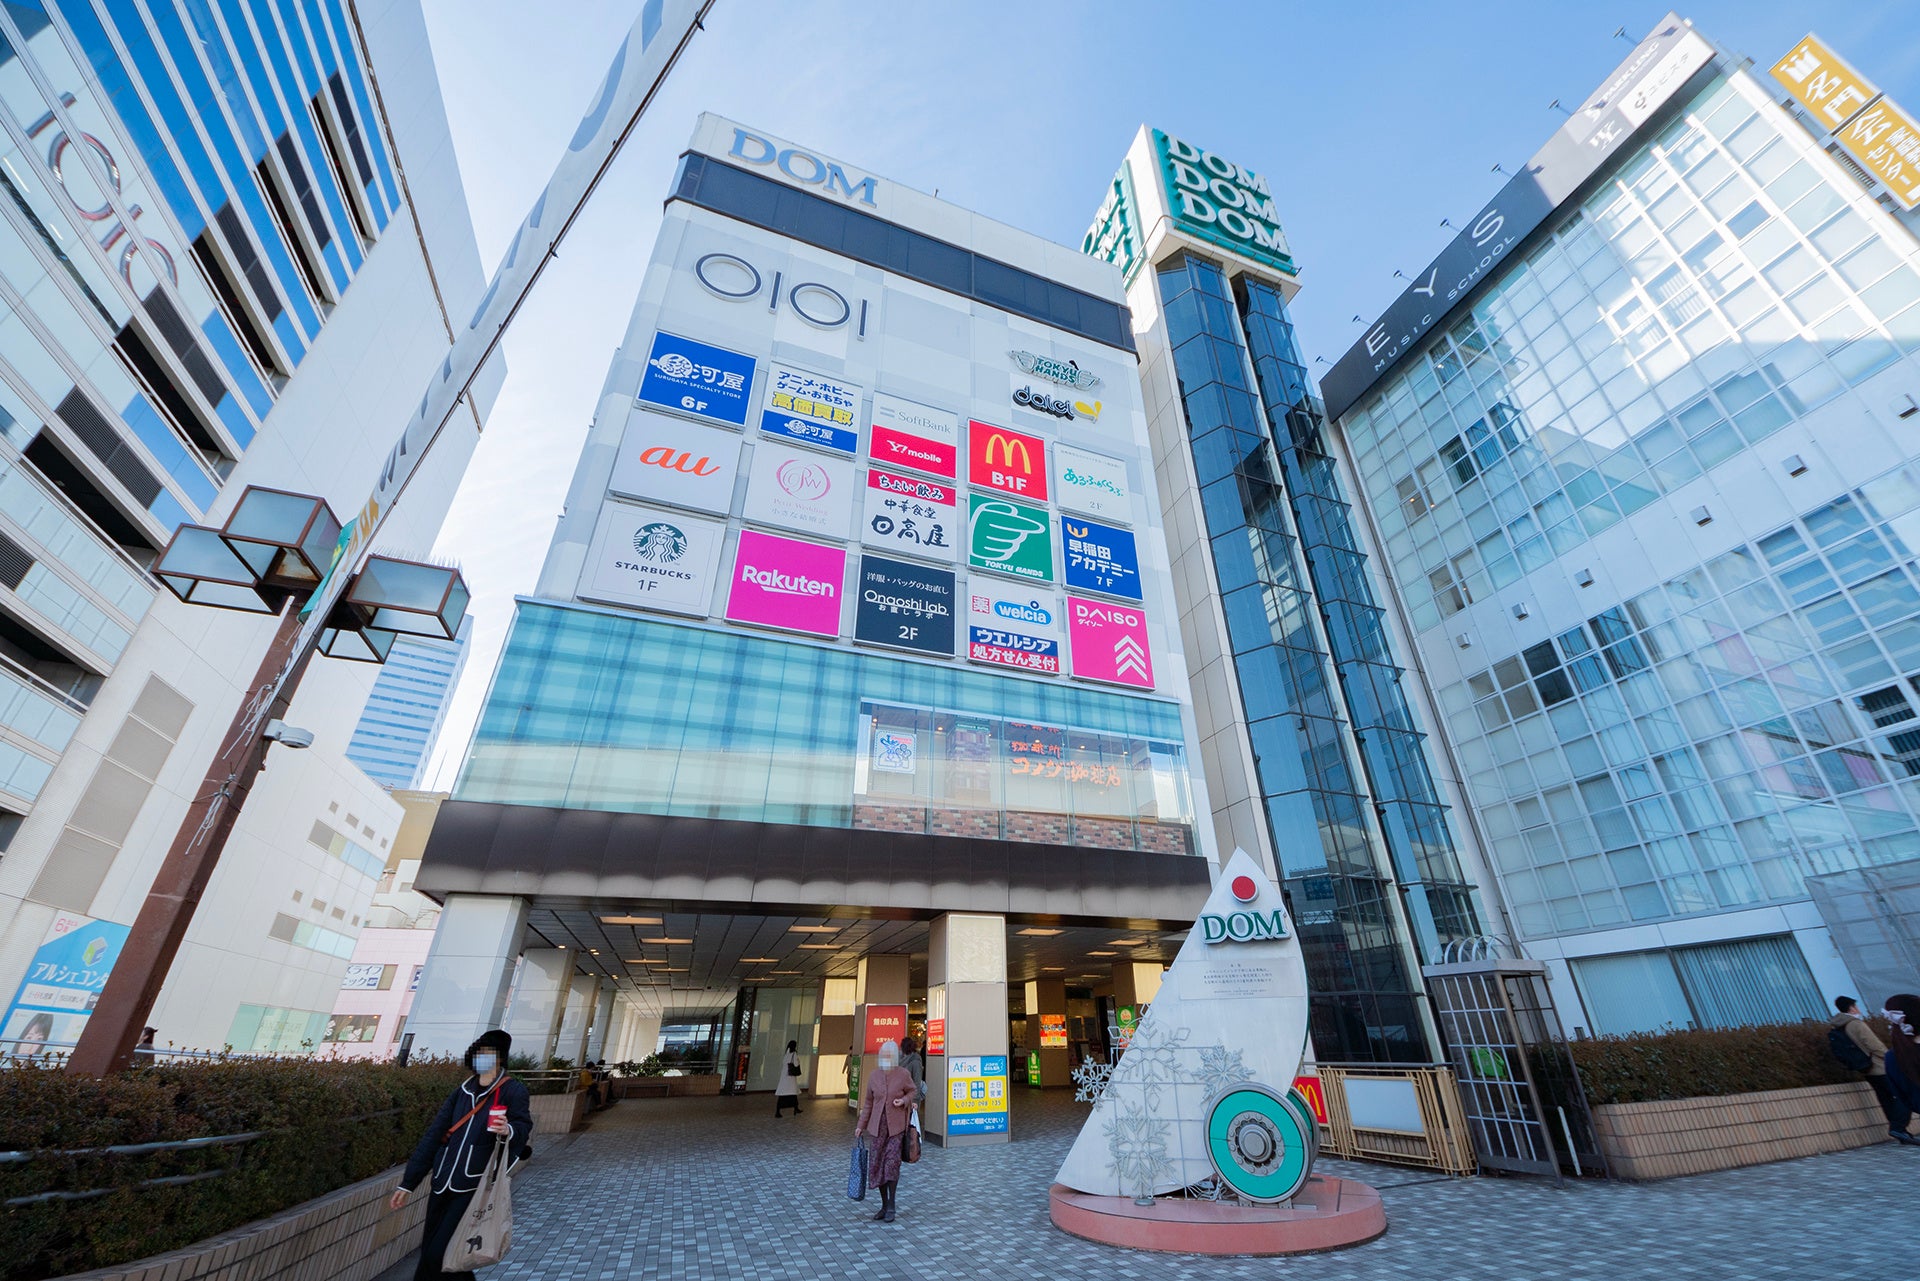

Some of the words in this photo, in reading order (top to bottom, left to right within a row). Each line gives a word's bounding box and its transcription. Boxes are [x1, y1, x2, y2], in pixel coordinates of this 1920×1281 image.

[1805, 70, 1893, 147] 名門会
[728, 128, 878, 209] DOM
[1168, 134, 1272, 200] DOM
[1866, 143, 1912, 186] センター
[1170, 158, 1281, 228] DOM
[1177, 188, 1292, 257] DOM
[1365, 209, 1504, 358] EYS
[1374, 313, 1432, 372] MUSIC
[1448, 235, 1515, 301] SCHOOL
[658, 353, 745, 392] 駿河屋
[1035, 365, 1076, 384] HANDS
[1036, 357, 1078, 378] TOKYU
[654, 373, 689, 386] SURUGAYA
[690, 382, 721, 395] SPECIALTY
[722, 391, 742, 399] STORE
[776, 380, 853, 408] ゲーム・おもちゃ
[778, 371, 854, 397] アニメ・ホビー
[681, 395, 708, 411] 6F
[771, 390, 855, 427] 高価買取
[899, 411, 951, 434] SoftBank
[639, 446, 721, 476] au
[879, 474, 945, 500] ちょい飲み
[992, 471, 1027, 492] B1F
[884, 498, 937, 520] 中華食堂
[871, 514, 949, 547] 日高屋
[1068, 539, 1111, 560] 早稲田
[615, 561, 692, 580] STARBUCKS
[985, 559, 1014, 572] TOKYU
[1016, 566, 1043, 577] HANDS
[1069, 553, 1135, 577] アカデミー
[637, 579, 658, 592] 1F
[742, 565, 834, 598] Rakuten
[866, 572, 950, 595] 洋服・バッグのお直し
[973, 596, 990, 613] 薬
[998, 600, 1047, 625] welcia
[1076, 605, 1138, 627] DAISO
[898, 626, 919, 641] 2F
[1078, 618, 1103, 627] ダイソー
[977, 629, 1051, 653] ウエルシア
[973, 644, 1056, 671] 処方せん受付
[1201, 910, 1286, 941] DOM
[873, 1017, 899, 1026] 無印良品
[953, 1061, 977, 1072] Aflac
